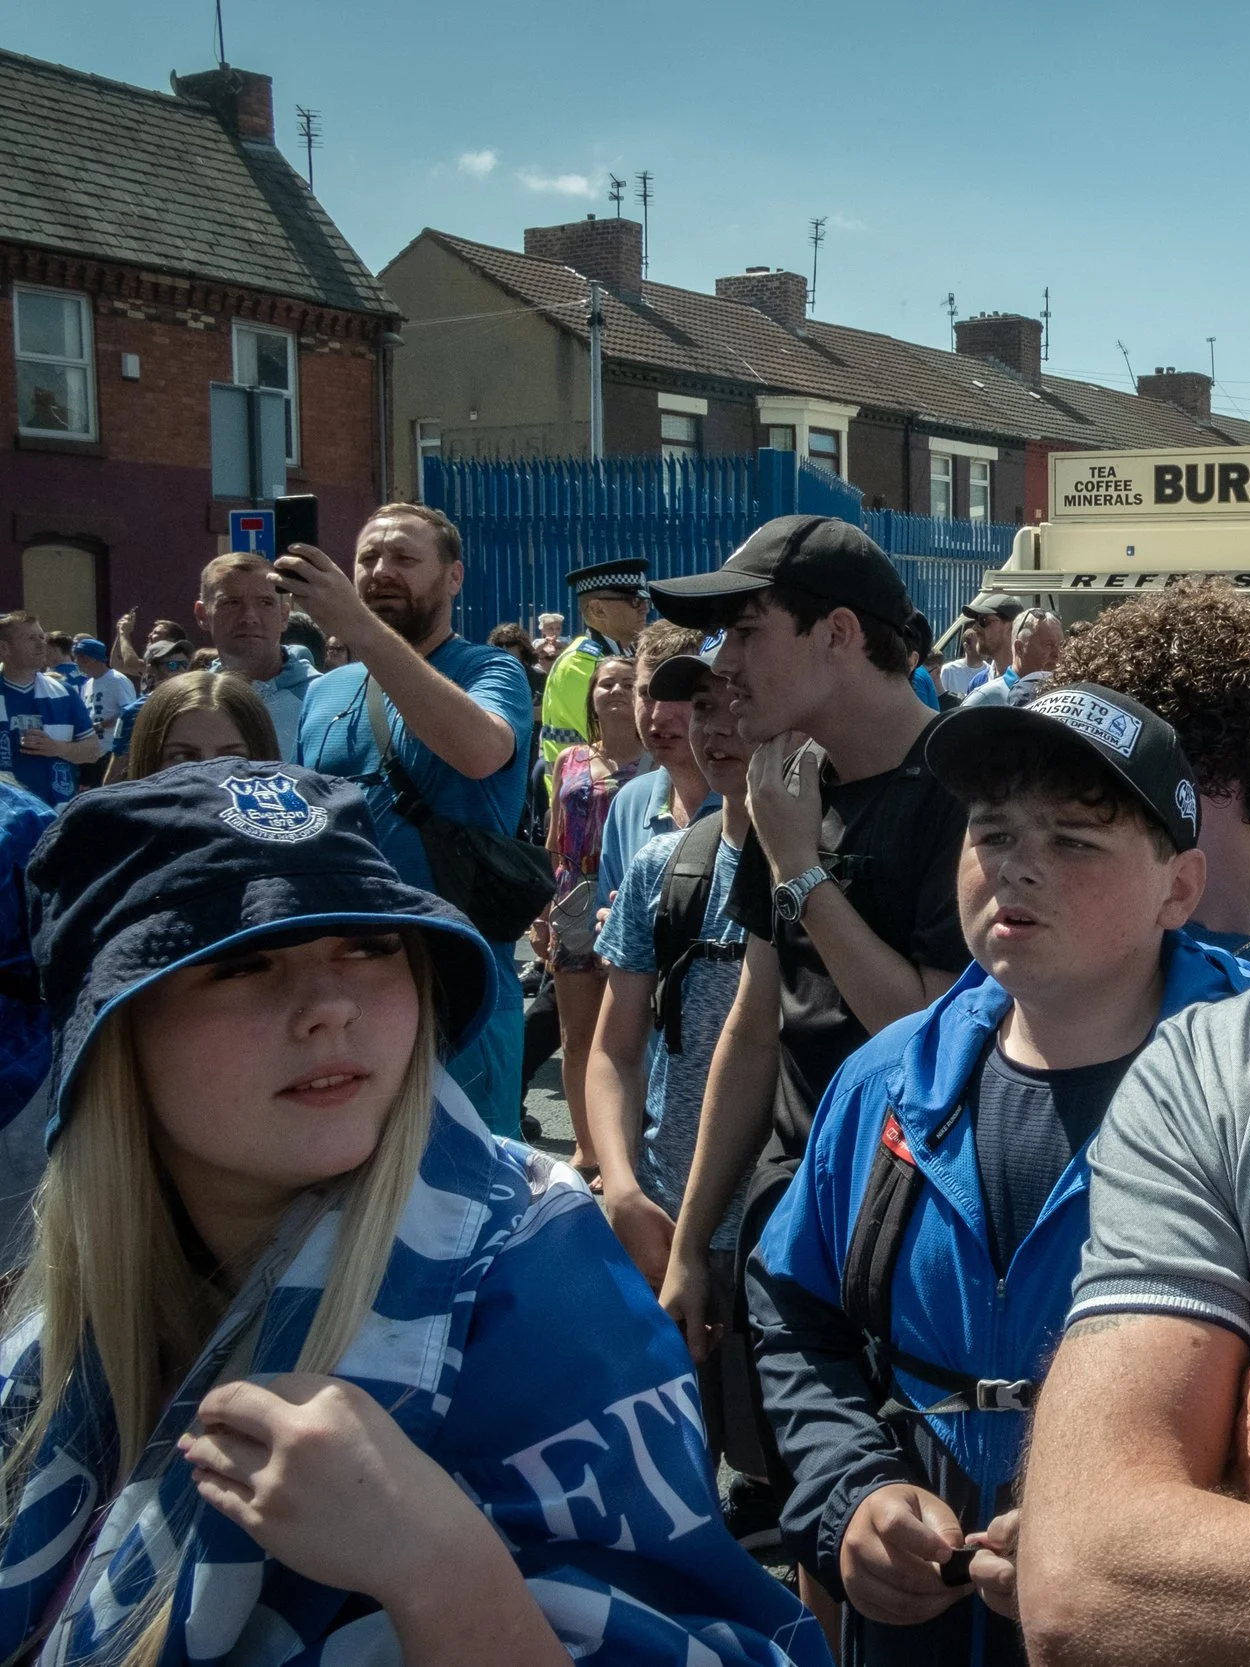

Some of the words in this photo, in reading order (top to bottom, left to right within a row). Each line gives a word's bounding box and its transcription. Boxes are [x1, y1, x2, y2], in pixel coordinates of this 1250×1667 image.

[1089, 466, 1117, 479] TEA
[1074, 479, 1133, 493] COFFEE
[1064, 493, 1144, 507] MINERALS
[1036, 705, 1084, 717] DISON
[1087, 712, 1104, 726] L4
[1091, 701, 1109, 716] TO
[1071, 721, 1120, 745] OPTIMUM
[247, 809, 305, 819] Everton
[935, 1124, 948, 1140] NIKE
